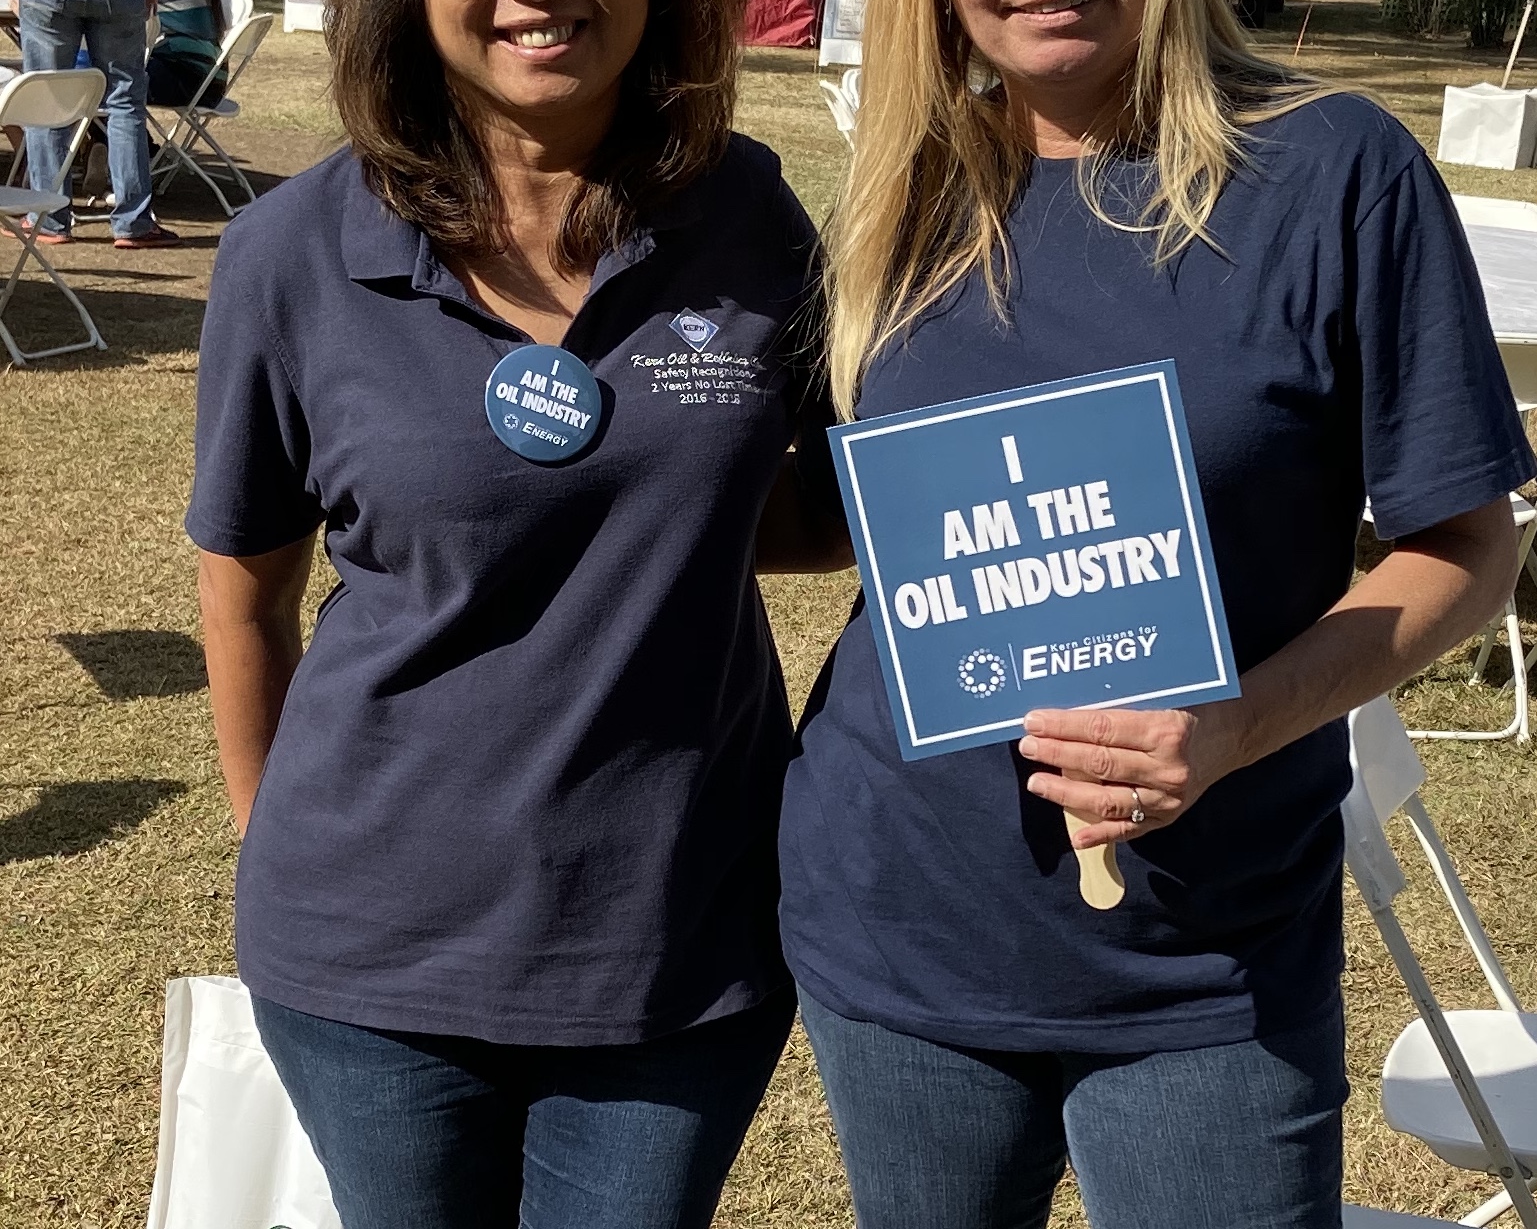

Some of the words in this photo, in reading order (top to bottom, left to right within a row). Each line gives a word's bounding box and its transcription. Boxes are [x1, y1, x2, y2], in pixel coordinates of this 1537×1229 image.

[550, 359, 560, 376] I
[667, 352, 688, 365] Oil
[689, 353, 700, 364] &
[650, 383, 660, 393] 2
[661, 381, 692, 392] Years
[694, 379, 711, 390] No
[712, 378, 736, 390] Lost
[653, 367, 689, 379] Safety
[691, 366, 757, 379] Recognition
[520, 369, 547, 393] AM
[550, 380, 579, 404] THE
[679, 393, 708, 404] 2016
[495, 382, 519, 404] OIL
[520, 391, 592, 430] INDUSTRY
[522, 421, 568, 447] ENERGY
[1001, 435, 1024, 484] I
[943, 500, 1021, 560] AM
[1026, 480, 1116, 540] THE
[894, 574, 968, 630] OIL
[973, 528, 1181, 615] INDUSTRY
[1050, 640, 1079, 652] Kern
[1083, 630, 1135, 646] Citizens
[1138, 625, 1157, 635] for
[1022, 632, 1158, 681] ENERGY
